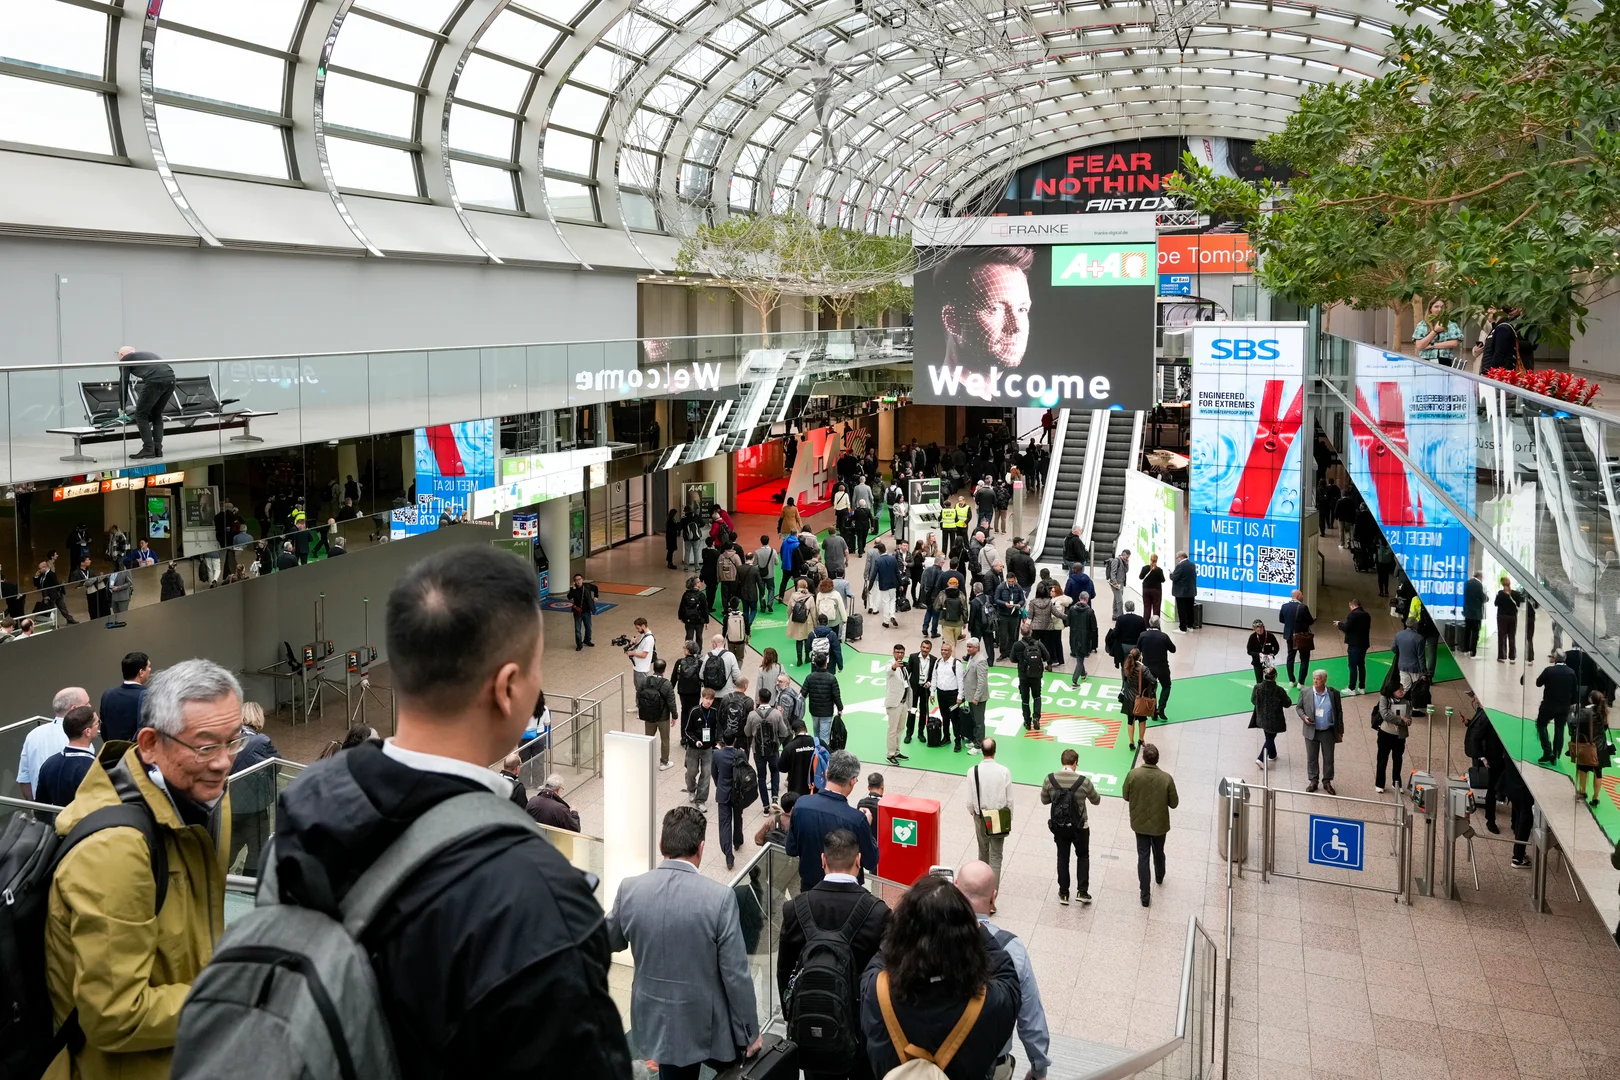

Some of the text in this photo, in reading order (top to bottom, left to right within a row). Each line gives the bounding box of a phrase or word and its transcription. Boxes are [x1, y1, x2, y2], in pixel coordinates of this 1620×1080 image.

[1067, 152, 1152, 174] FEAR
[1085, 196, 1176, 212] AIRTOX
[1008, 224, 1069, 234] FRANKE
[1060, 252, 1120, 279] A+A
[1211, 338, 1280, 360] SBS
[928, 364, 1111, 399] Welcome
[1198, 392, 1244, 400] ENGINEERED
[1212, 520, 1276, 538] MEET US AT
[1194, 539, 1255, 567] Hall 16
[1195, 564, 1254, 582] BOOTH C76
